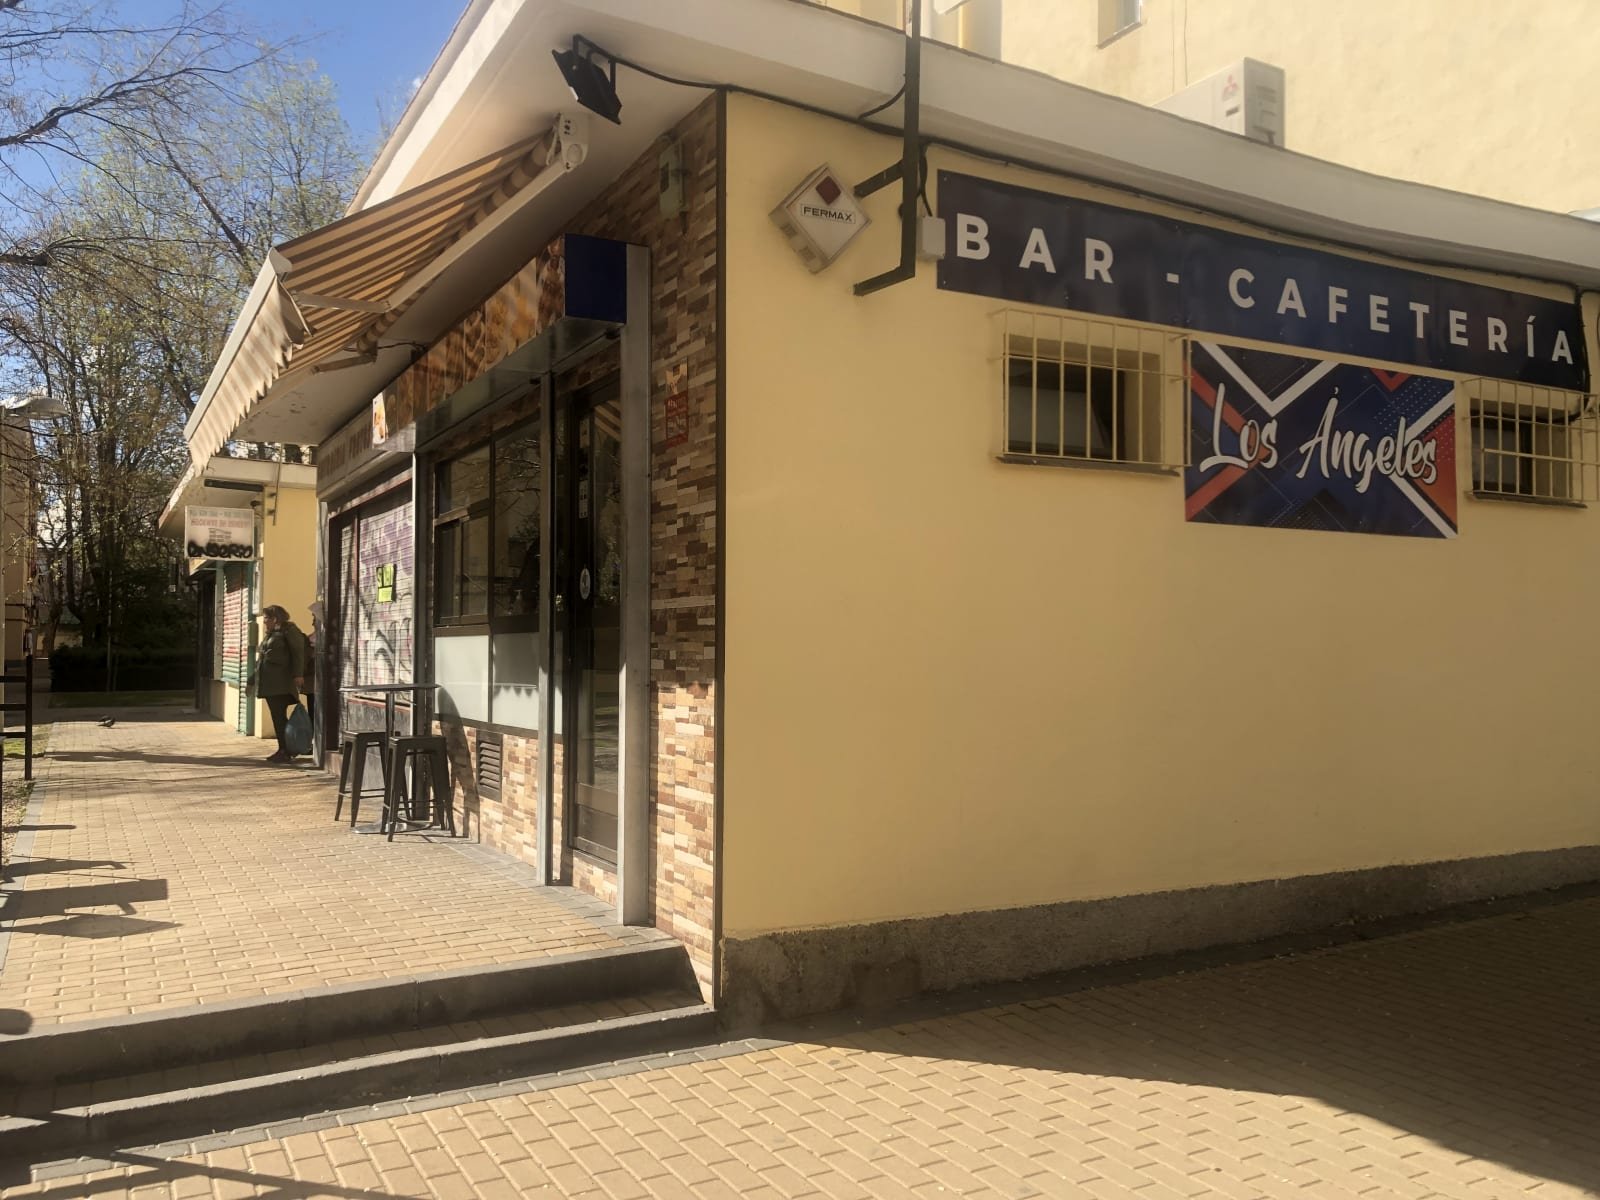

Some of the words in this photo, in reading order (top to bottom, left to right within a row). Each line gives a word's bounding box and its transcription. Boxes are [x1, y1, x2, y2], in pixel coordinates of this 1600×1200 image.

[803, 206, 853, 222] FERMAX
[956, 212, 1114, 284] BAR
[1166, 272, 1180, 284] -
[1228, 268, 1574, 365] CAFETERÍA
[1199, 382, 1278, 473] Los
